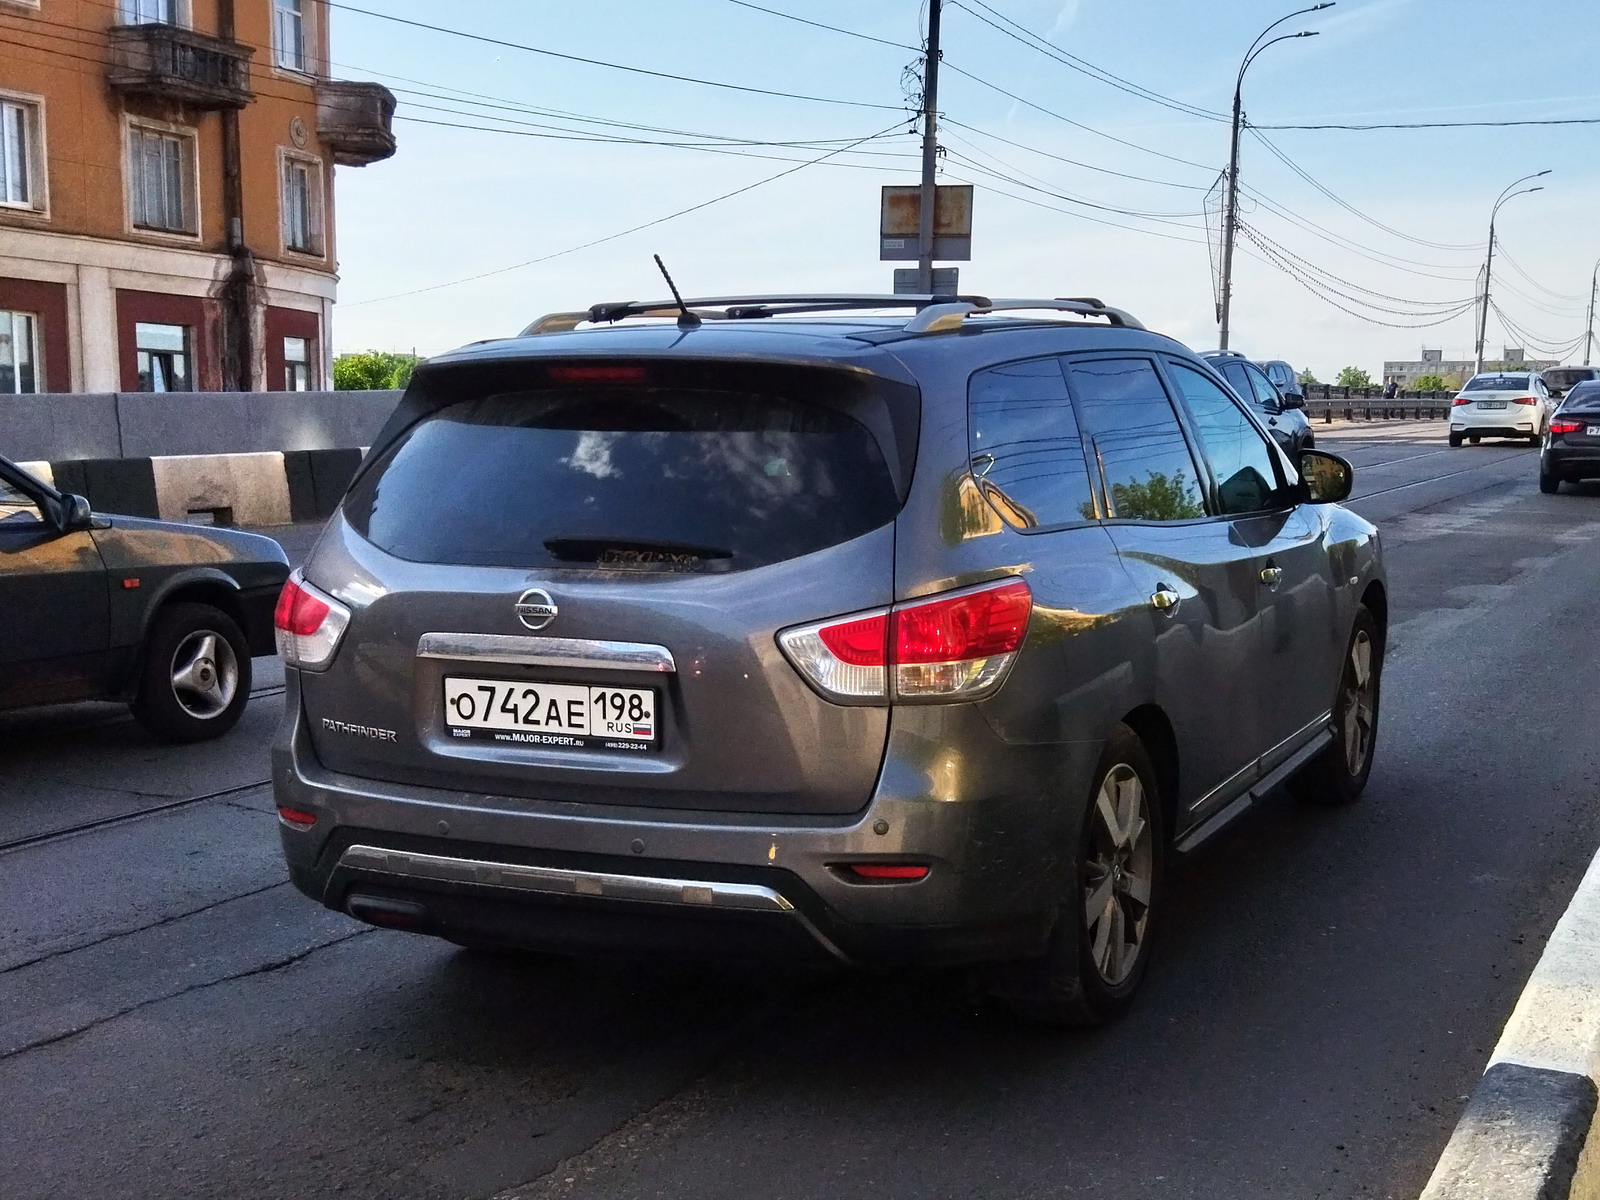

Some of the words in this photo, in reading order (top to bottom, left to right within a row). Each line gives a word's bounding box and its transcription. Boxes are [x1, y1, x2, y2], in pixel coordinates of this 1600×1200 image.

[517, 605, 552, 615] NISSAN
[594, 691, 644, 722] 198
[322, 718, 397, 742] PATHFINDER
[607, 721, 632, 734] RUS
